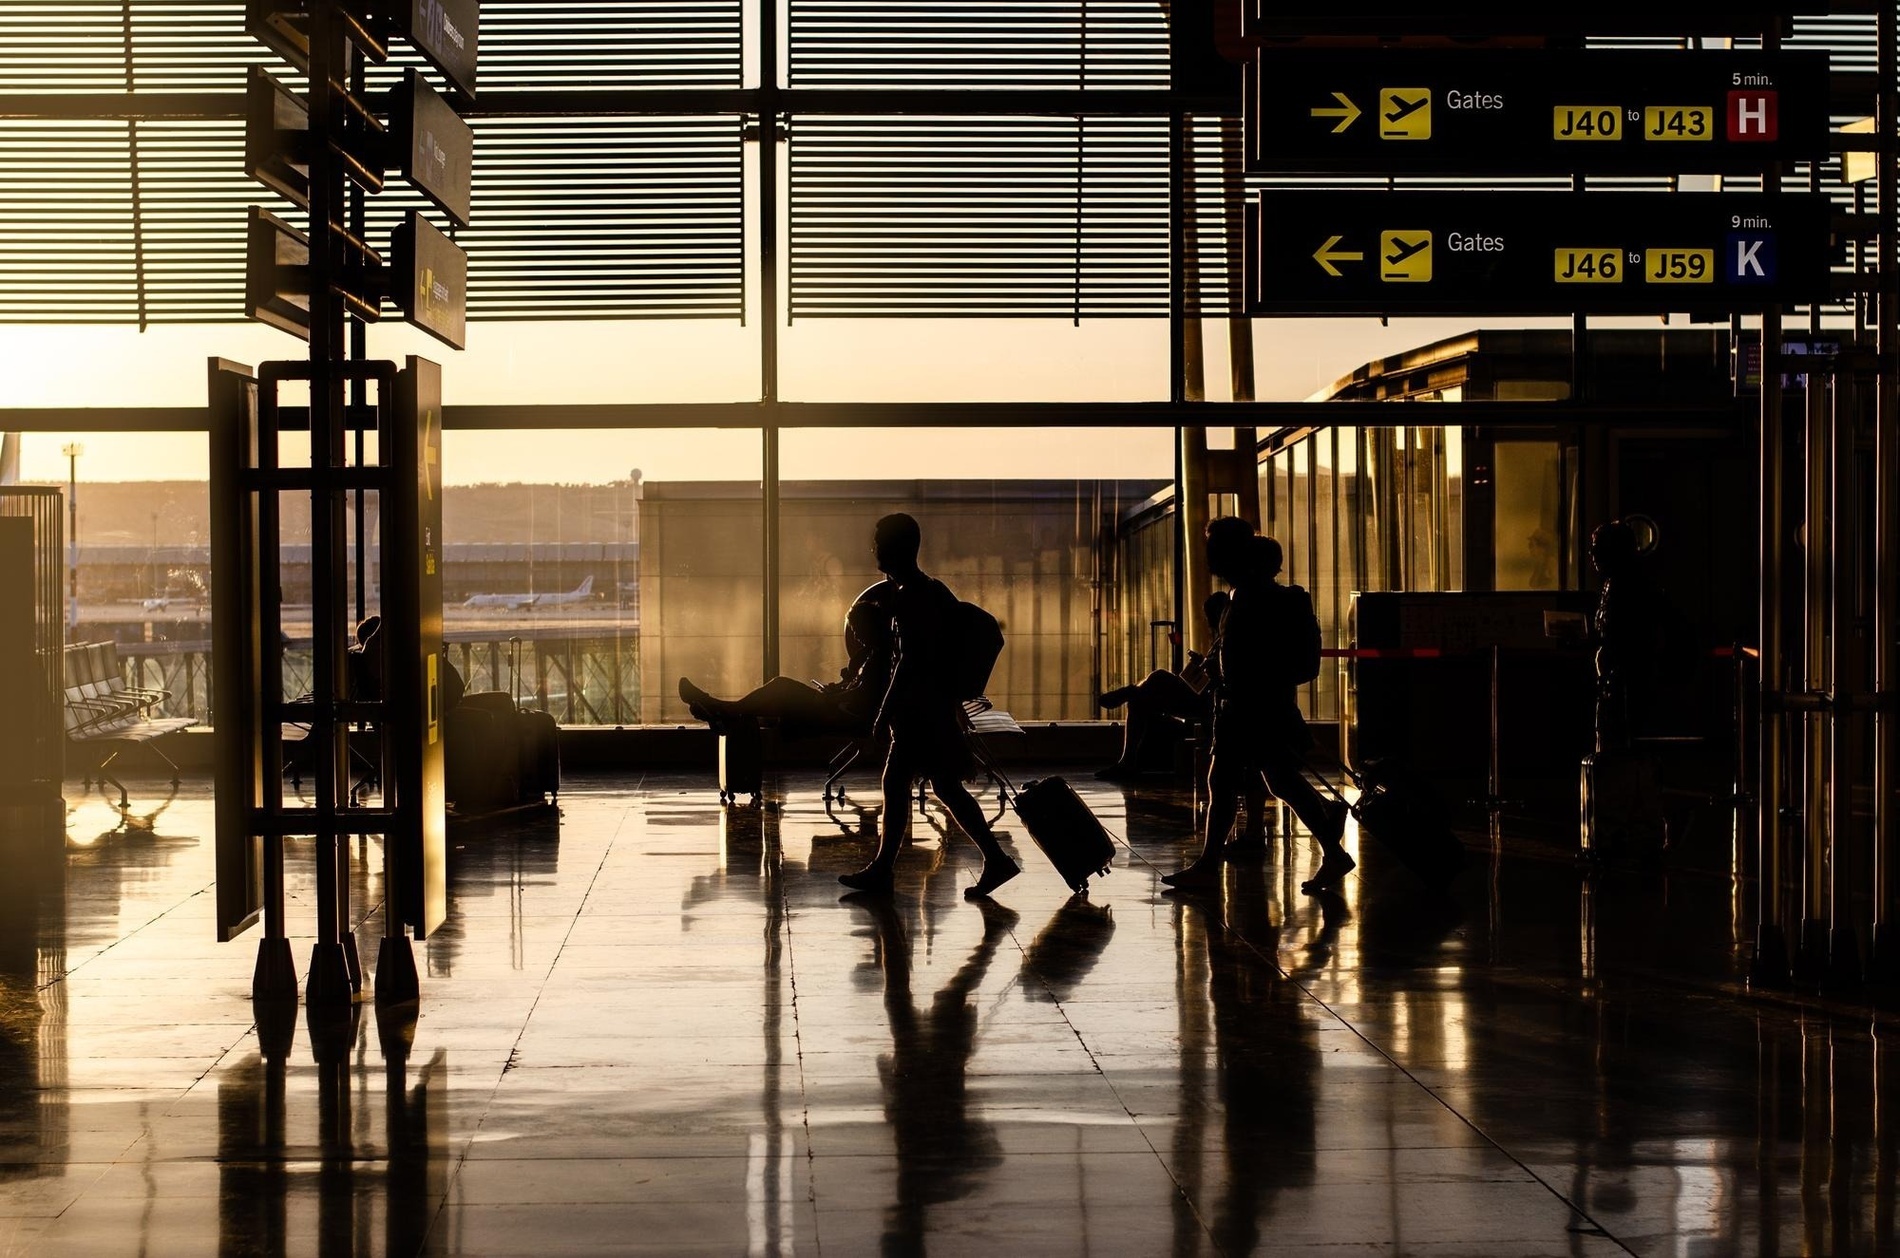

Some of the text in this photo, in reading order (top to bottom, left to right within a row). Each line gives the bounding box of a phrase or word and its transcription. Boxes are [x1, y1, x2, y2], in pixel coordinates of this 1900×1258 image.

[1732, 72, 1773, 86] 5 min.
[1447, 89, 1504, 109] Gates
[1560, 98, 1767, 136] J40 to J43 H
[1731, 215, 1772, 228] 9 min.
[1447, 232, 1505, 252] Gates
[1561, 240, 1766, 279] J46 to J59 K
